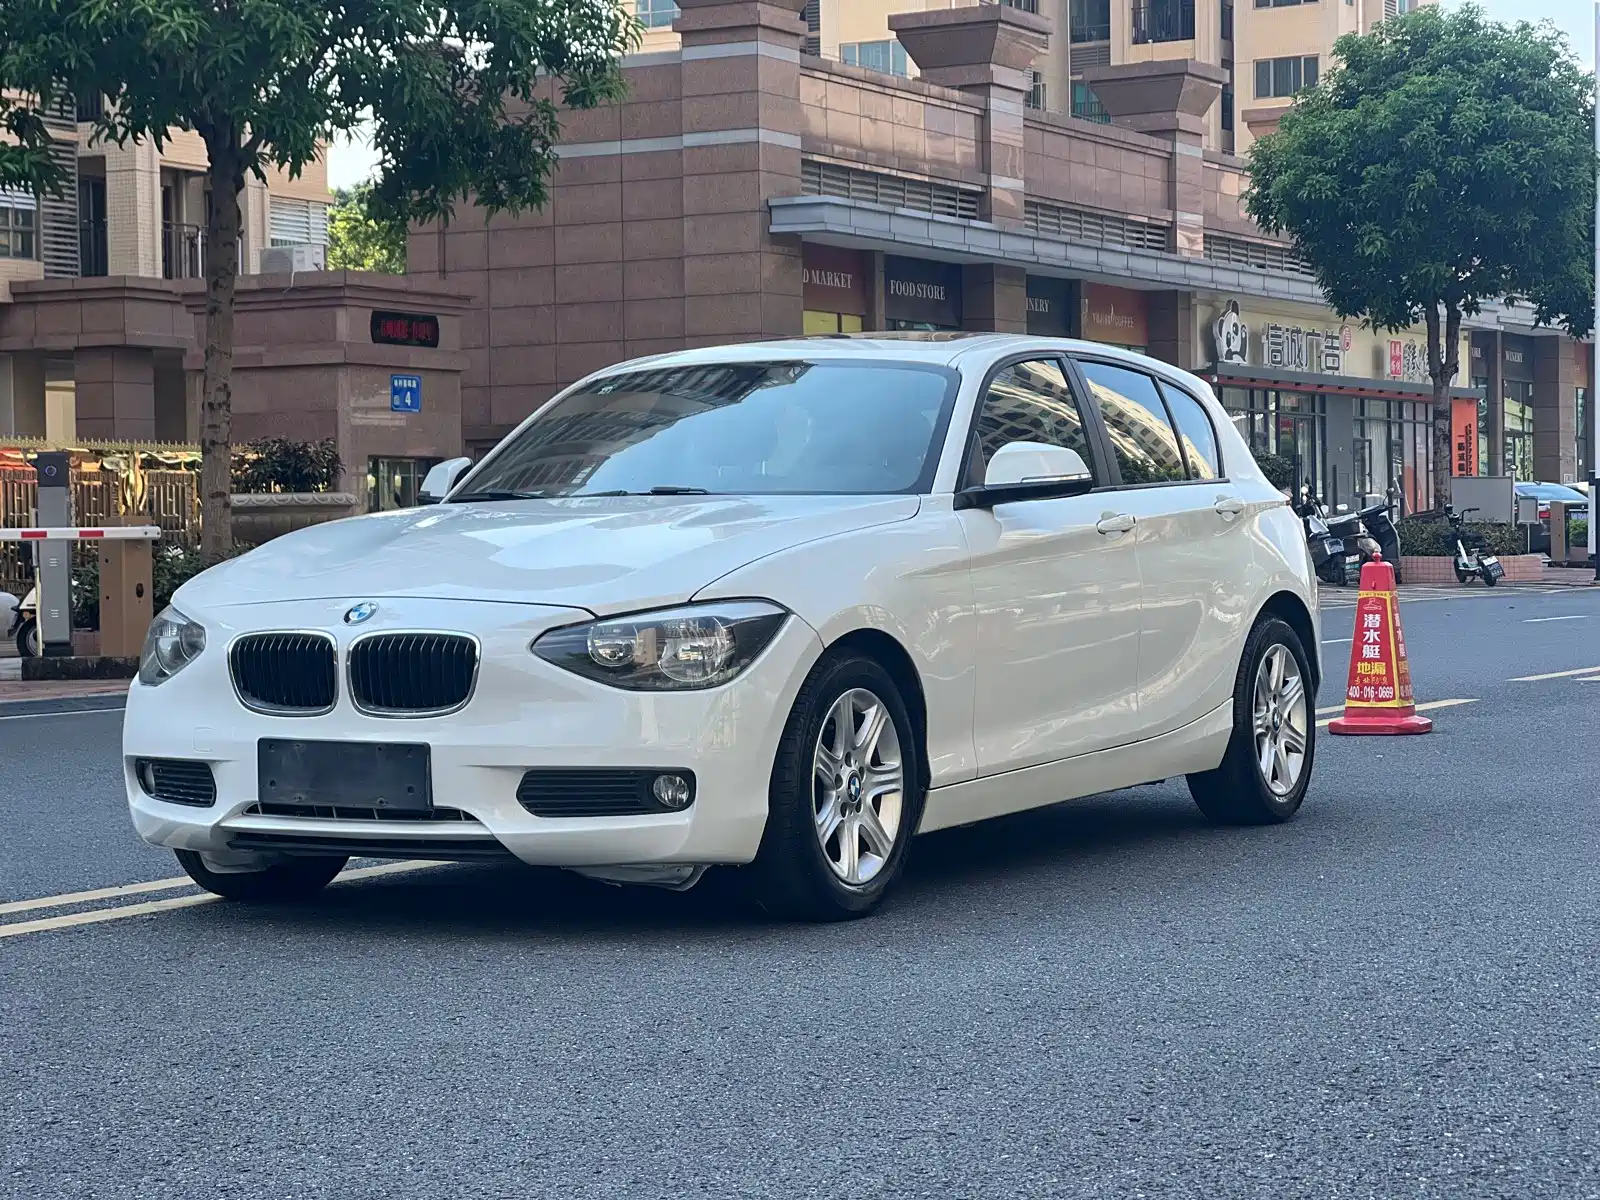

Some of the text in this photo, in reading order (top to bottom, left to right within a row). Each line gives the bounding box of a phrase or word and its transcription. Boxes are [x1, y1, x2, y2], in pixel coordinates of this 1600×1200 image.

[811, 269, 853, 289] MARKET
[890, 280, 946, 300] FOOD STORE
[1263, 322, 1340, 373] 信诚广告
[404, 391, 412, 406] 4
[1362, 614, 1381, 659] 潜水艇
[1356, 661, 1386, 675] 地漏
